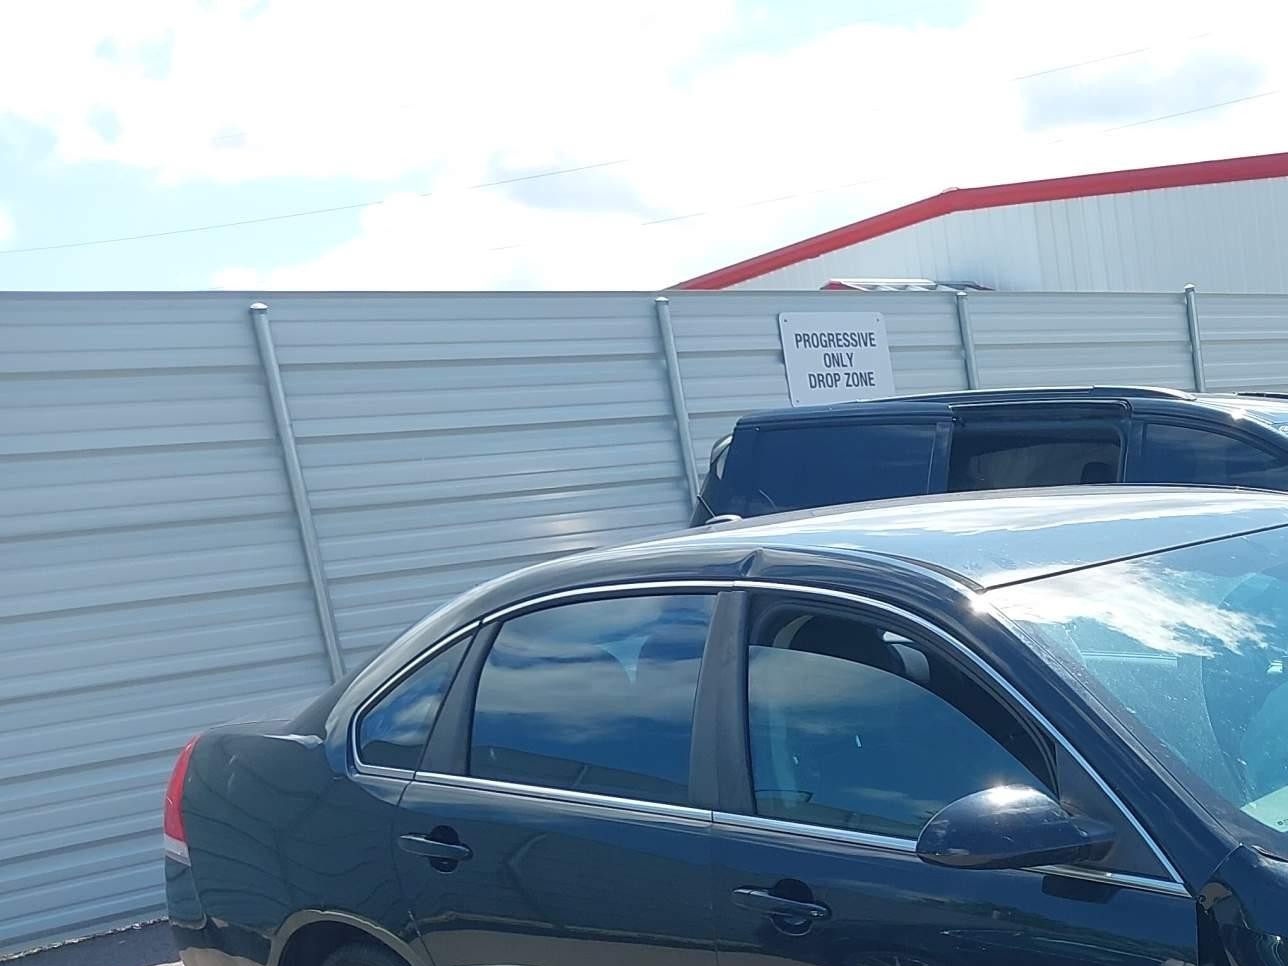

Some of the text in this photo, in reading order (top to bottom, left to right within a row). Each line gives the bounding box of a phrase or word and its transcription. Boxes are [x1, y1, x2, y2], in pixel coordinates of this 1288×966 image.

[795, 332, 876, 349] PROGRESSIVE
[823, 352, 854, 369] ONLY
[808, 371, 876, 389] DROP ZONE
